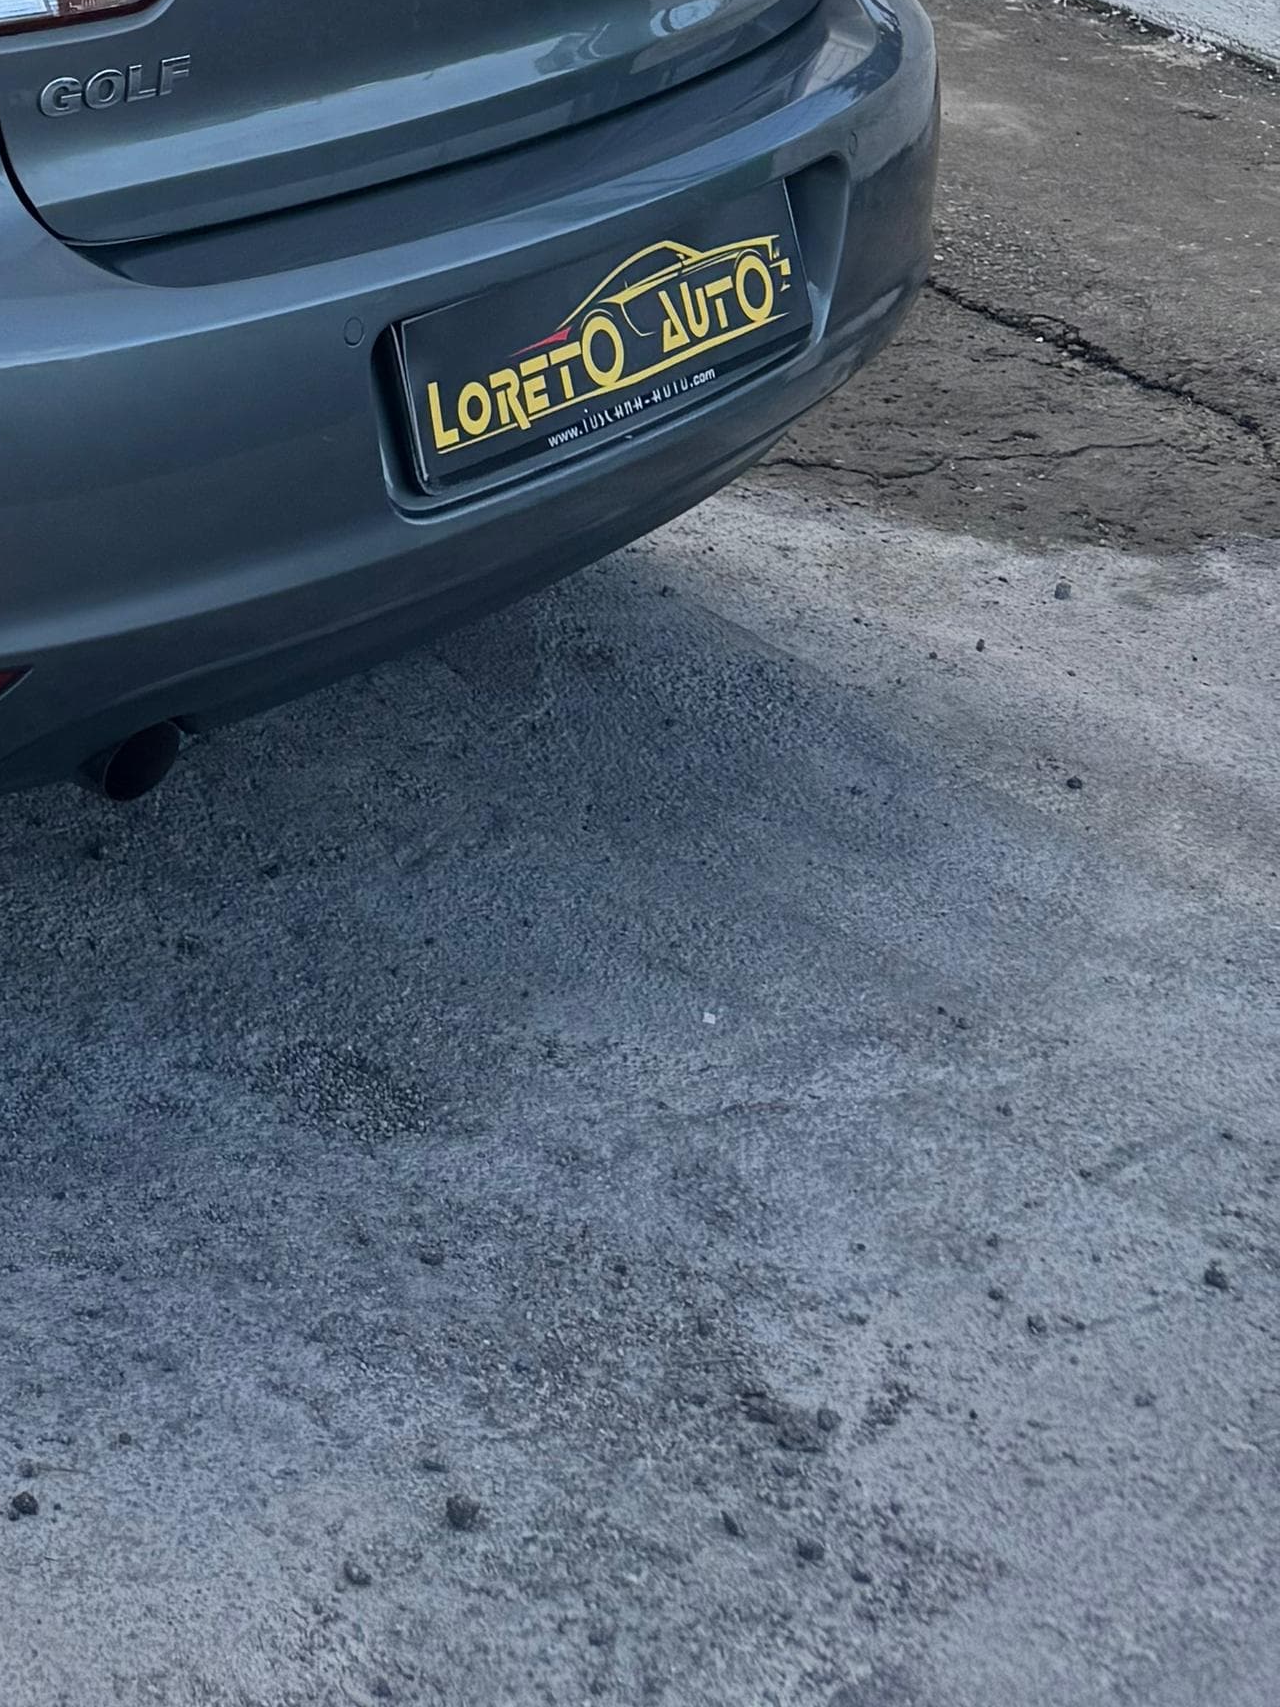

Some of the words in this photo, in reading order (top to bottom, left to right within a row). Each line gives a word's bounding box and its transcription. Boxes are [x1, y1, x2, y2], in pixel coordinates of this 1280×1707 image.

[39, 54, 191, 118] GOLF
[427, 315, 625, 450] LORETO
[658, 254, 774, 353] AUTO
